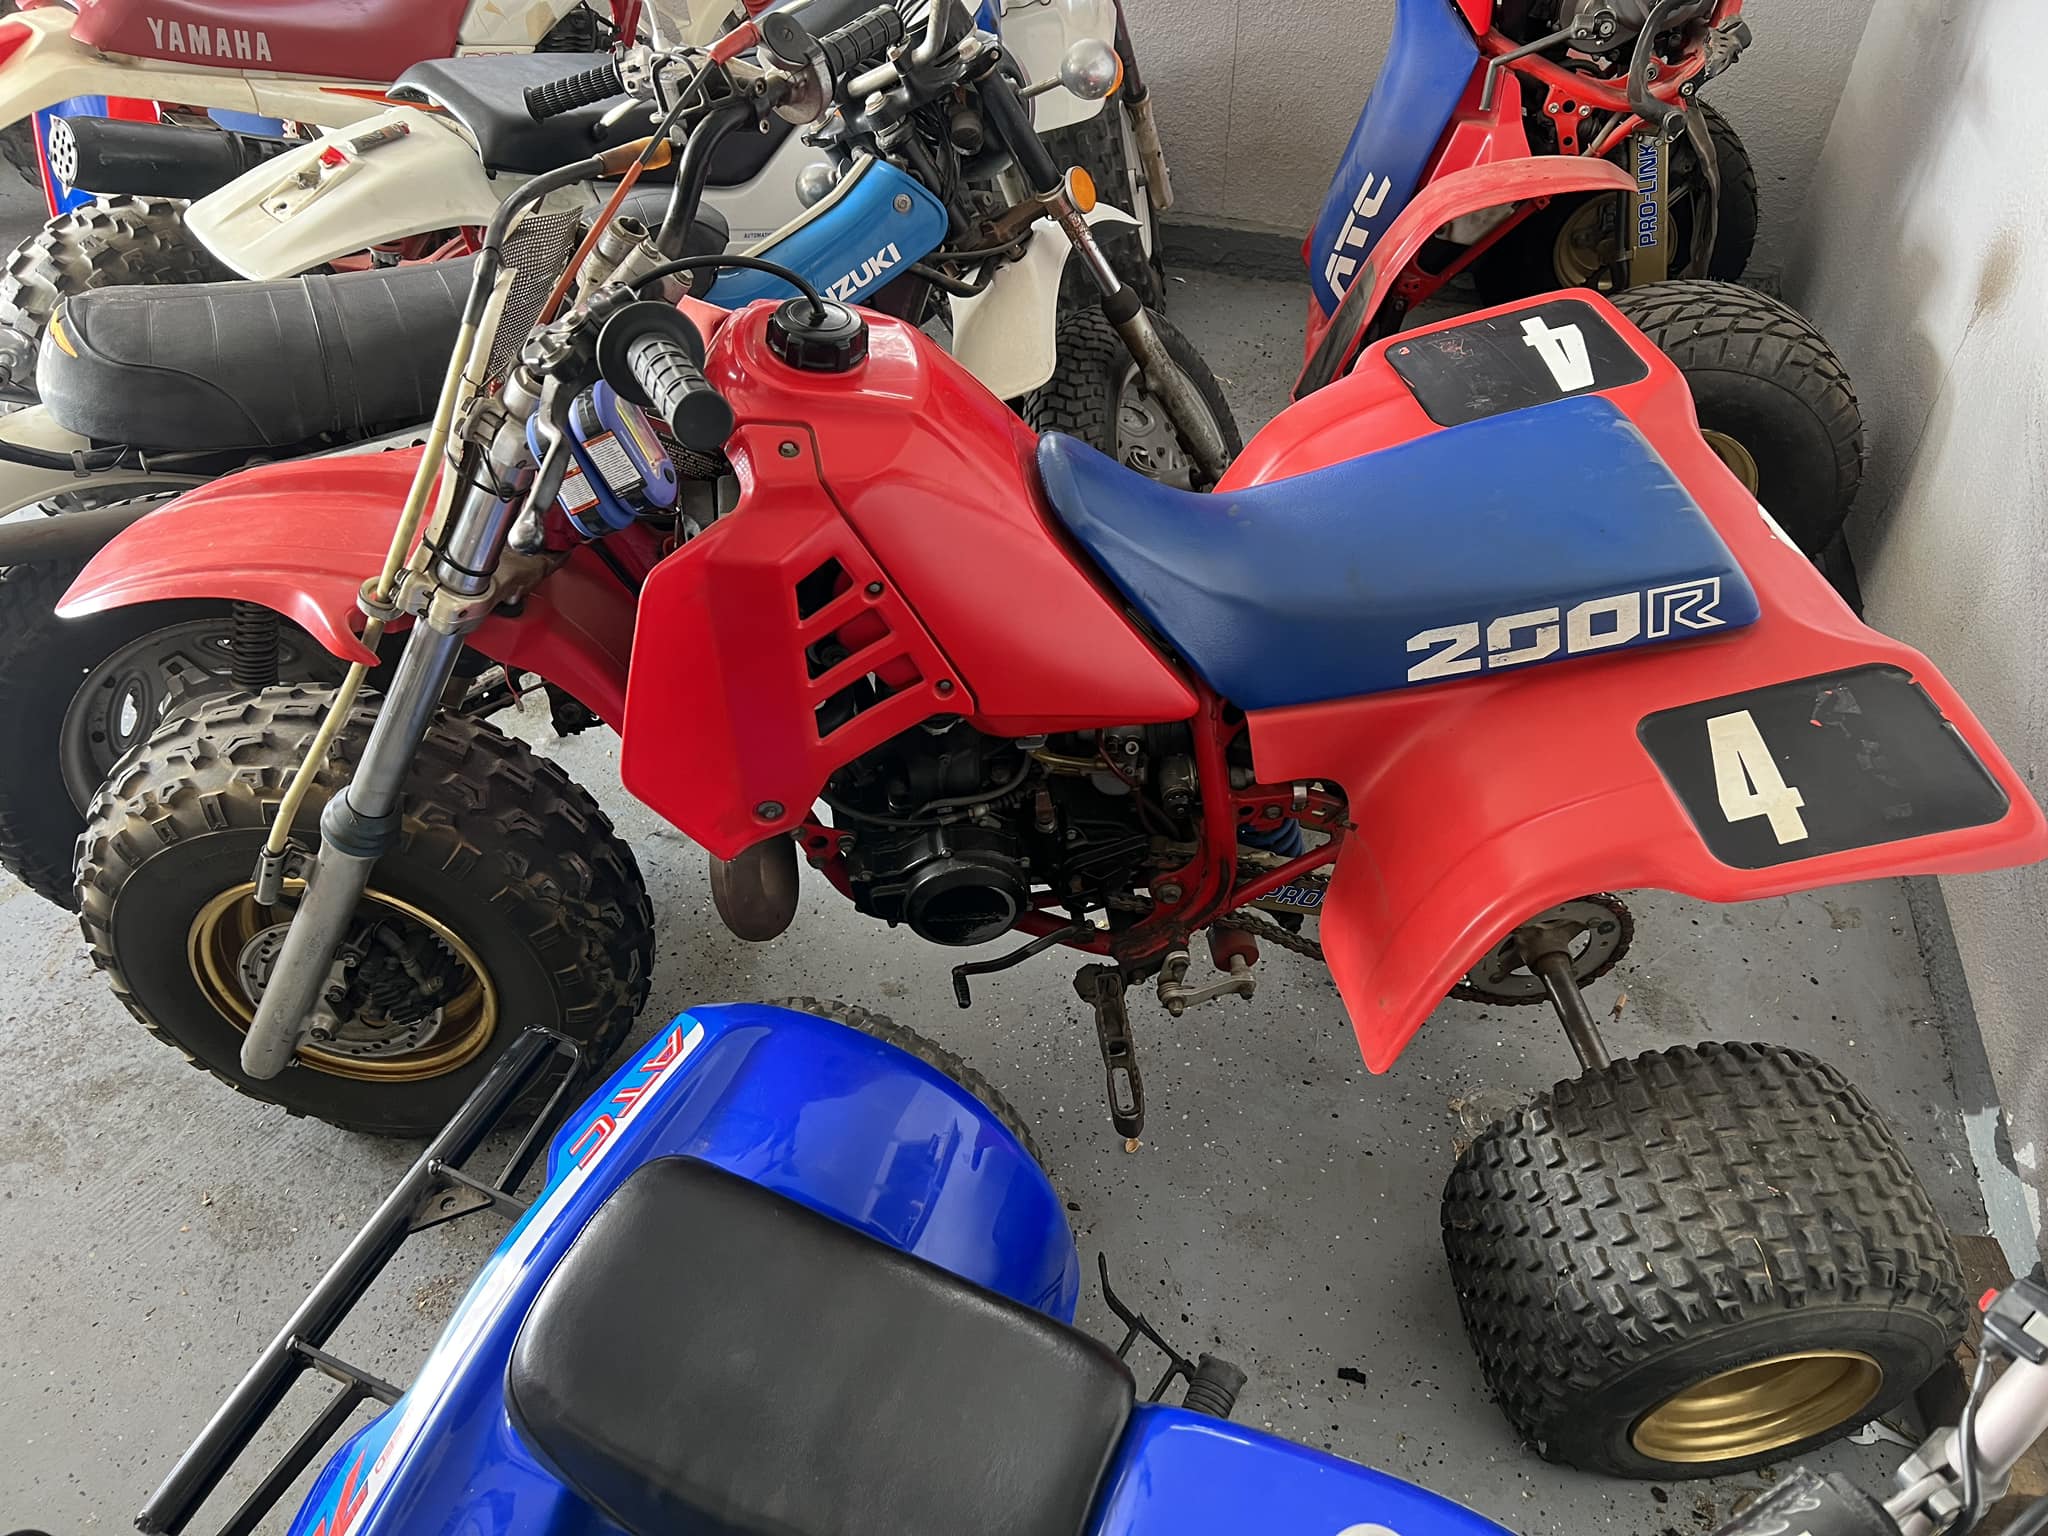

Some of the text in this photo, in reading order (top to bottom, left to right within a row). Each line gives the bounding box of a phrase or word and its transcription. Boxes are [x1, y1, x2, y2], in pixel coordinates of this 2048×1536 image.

[147, 17, 272, 62] YAMAHA
[1325, 172, 1392, 301] ATC
[1638, 143, 1658, 247] PRO-LINK
[825, 242, 902, 301] ZUKI
[1519, 316, 1595, 392] 4
[1406, 576, 1727, 682] 250R
[1707, 709, 1808, 845] 4
[1256, 884, 1326, 908] PRO
[568, 1023, 685, 1171] ATC
